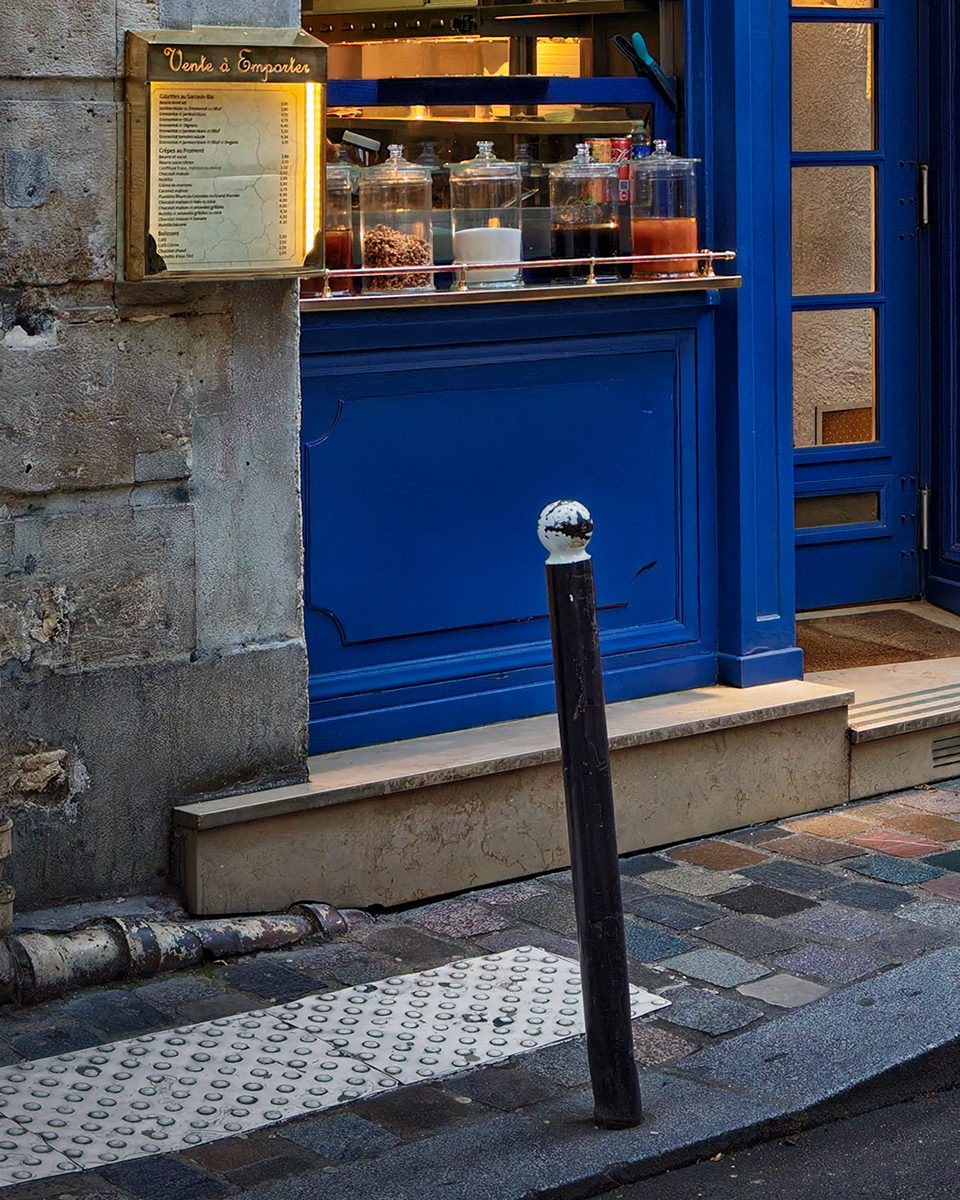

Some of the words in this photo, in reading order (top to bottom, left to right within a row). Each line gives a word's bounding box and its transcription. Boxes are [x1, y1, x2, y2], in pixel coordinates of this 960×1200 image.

[163, 47, 214, 72] Vente
[219, 57, 231, 73] à
[237, 48, 311, 83] Emporter
